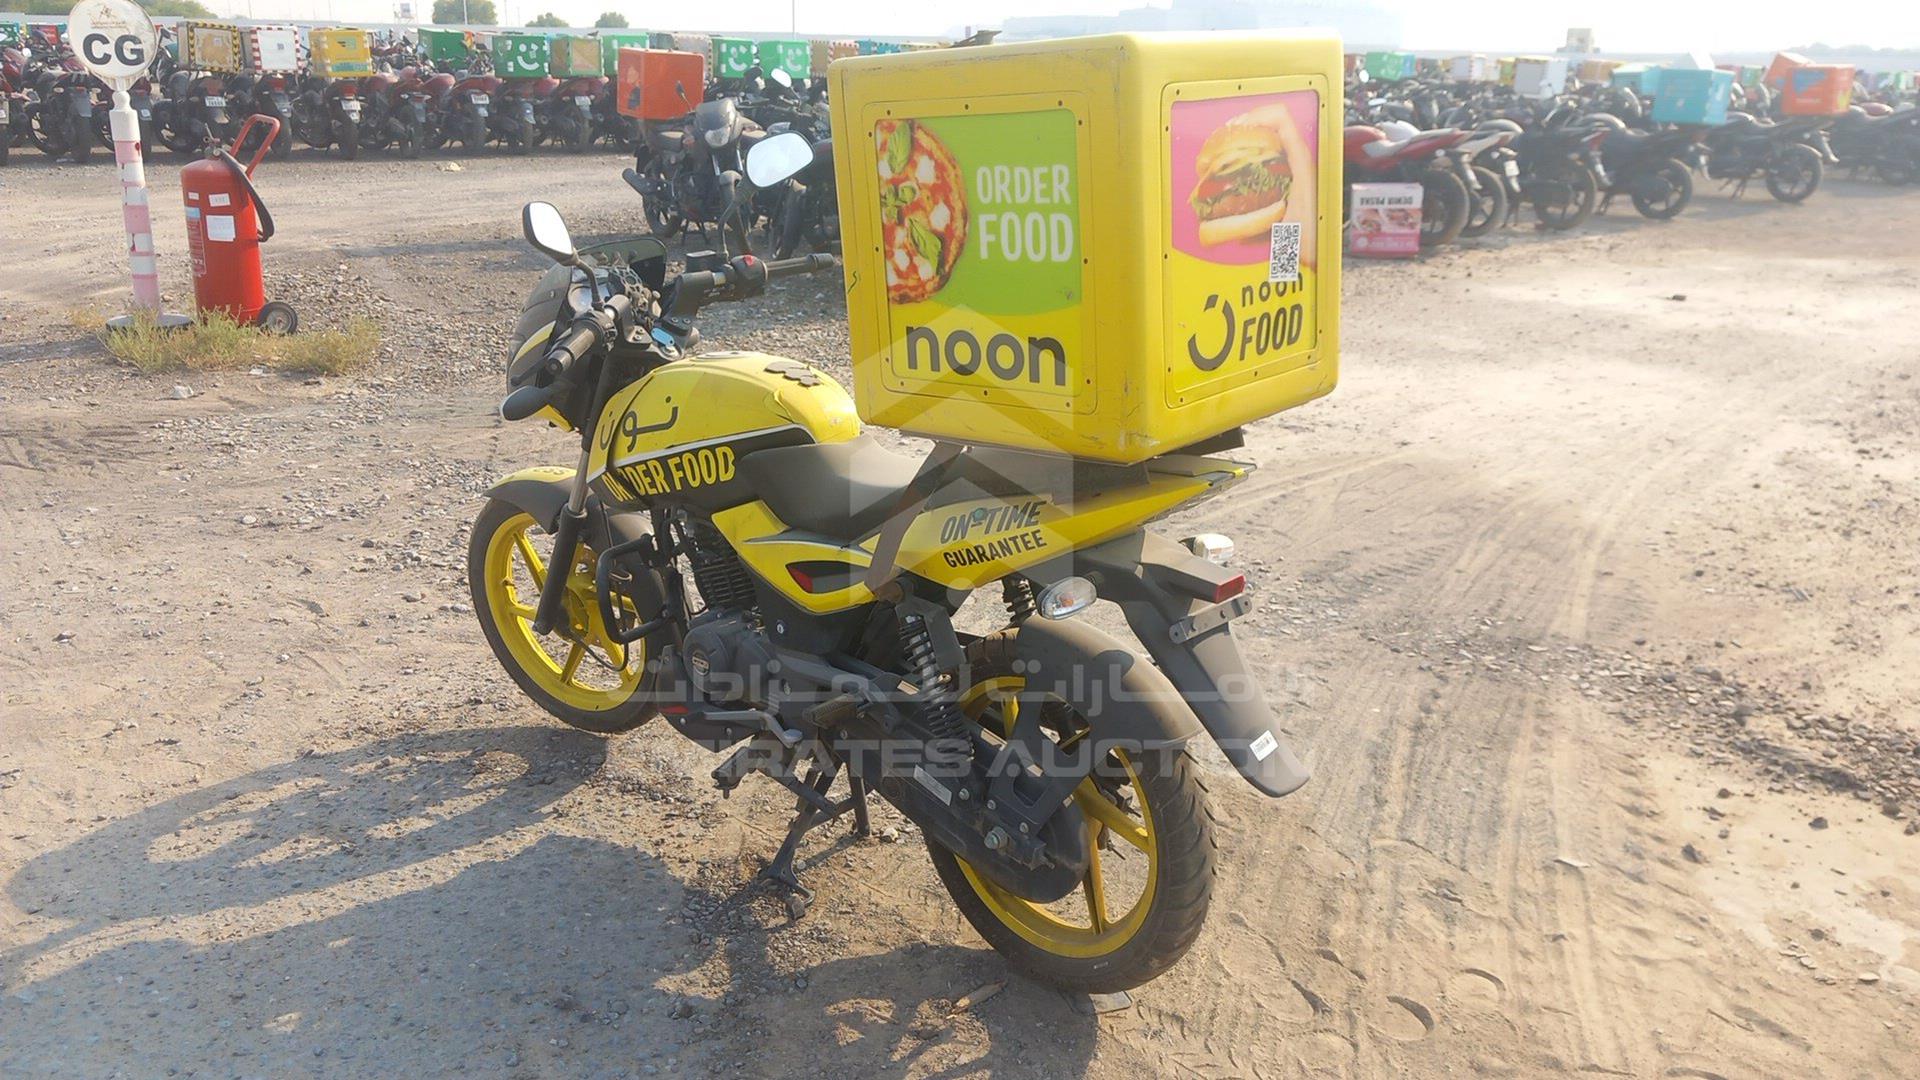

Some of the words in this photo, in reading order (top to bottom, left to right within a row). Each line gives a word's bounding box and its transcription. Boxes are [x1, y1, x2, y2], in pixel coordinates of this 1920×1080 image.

[83, 33, 145, 66] CG
[976, 164, 1072, 205] ORDER
[978, 211, 1074, 262] FOOD
[1242, 272, 1303, 308] noon
[1239, 303, 1303, 361] FOOD
[906, 326, 1066, 387] noon
[667, 446, 736, 491] FOOD
[943, 529, 1047, 568] GUARANTEE
